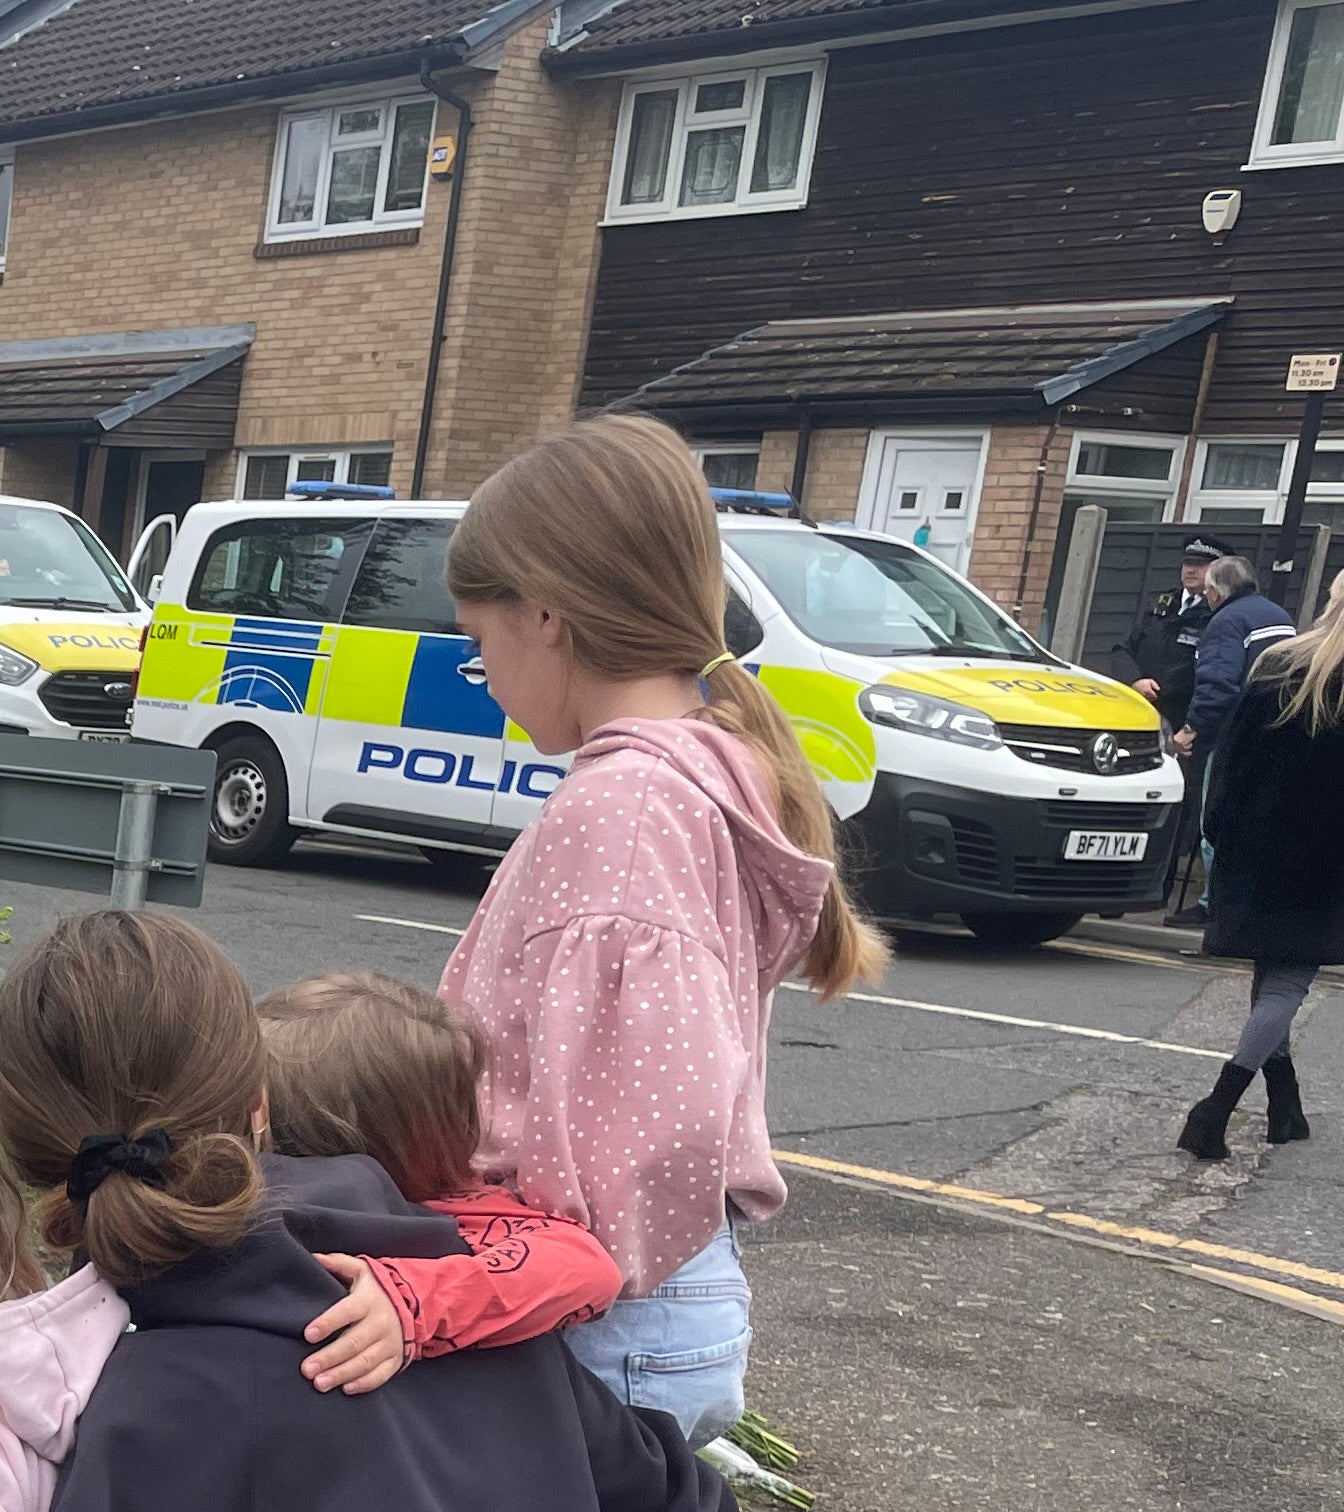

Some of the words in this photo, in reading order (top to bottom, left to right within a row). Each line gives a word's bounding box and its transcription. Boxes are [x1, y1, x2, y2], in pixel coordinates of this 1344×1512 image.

[48, 632, 139, 651] POLIC
[986, 678, 1119, 699] POLICE
[356, 740, 570, 800] POLIC
